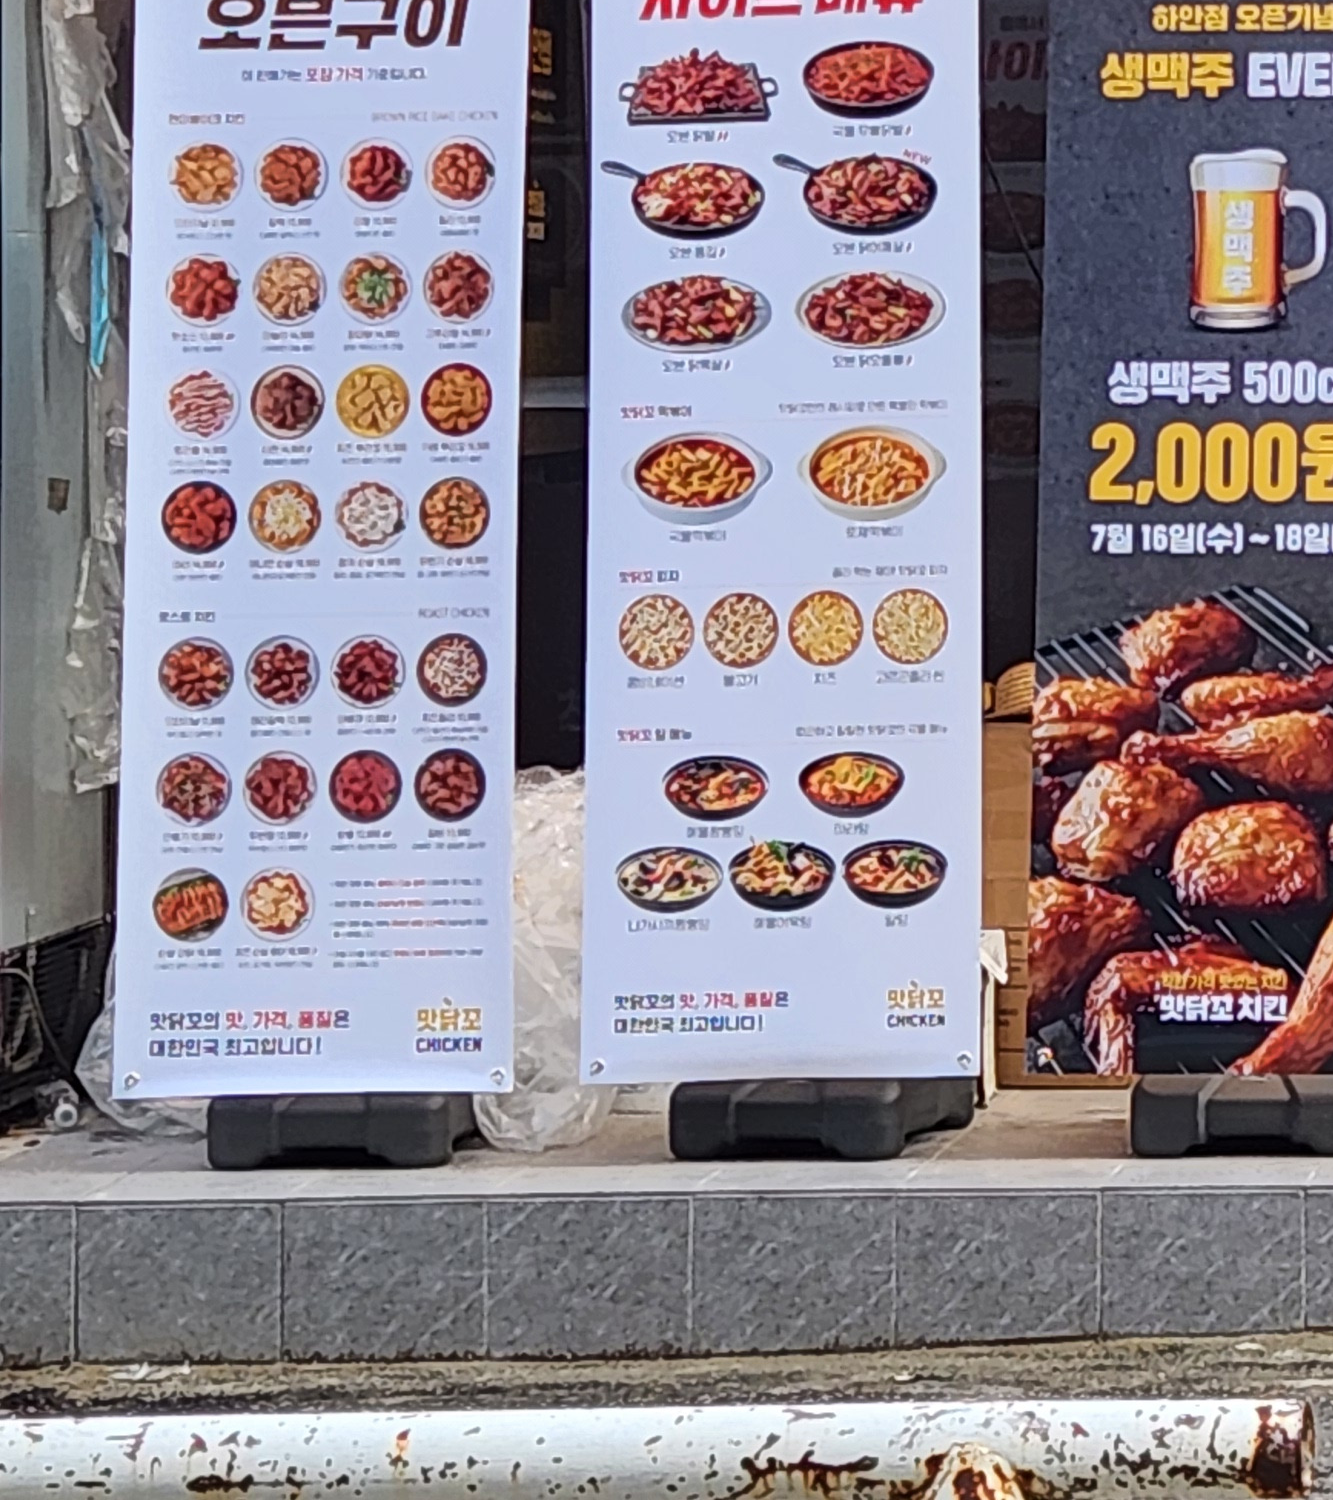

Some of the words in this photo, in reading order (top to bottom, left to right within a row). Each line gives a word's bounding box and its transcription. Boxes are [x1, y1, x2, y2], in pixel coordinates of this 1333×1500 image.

[1151, 4, 1231, 33] 하안점
[1099, 51, 1235, 100] 생맥주
[1222, 199, 1254, 297] 생맥주
[1107, 360, 1232, 405] 생맥주
[1090, 522, 1134, 554] 7월
[1141, 521, 1244, 555] 16일(수)
[886, 988, 945, 1010] 맛닭꼬
[1159, 994, 1234, 1022] 맛닭꼬
[1237, 994, 1289, 1022] 치킨
[149, 1011, 220, 1031] 맛닭꼬의
[416, 1007, 482, 1031] 맛닭꼬
[613, 1016, 676, 1034] 대한민국
[886, 1013, 946, 1029] CHICKEN
[148, 1037, 220, 1058] 대한민국
[415, 1037, 483, 1054] CHICKEN
